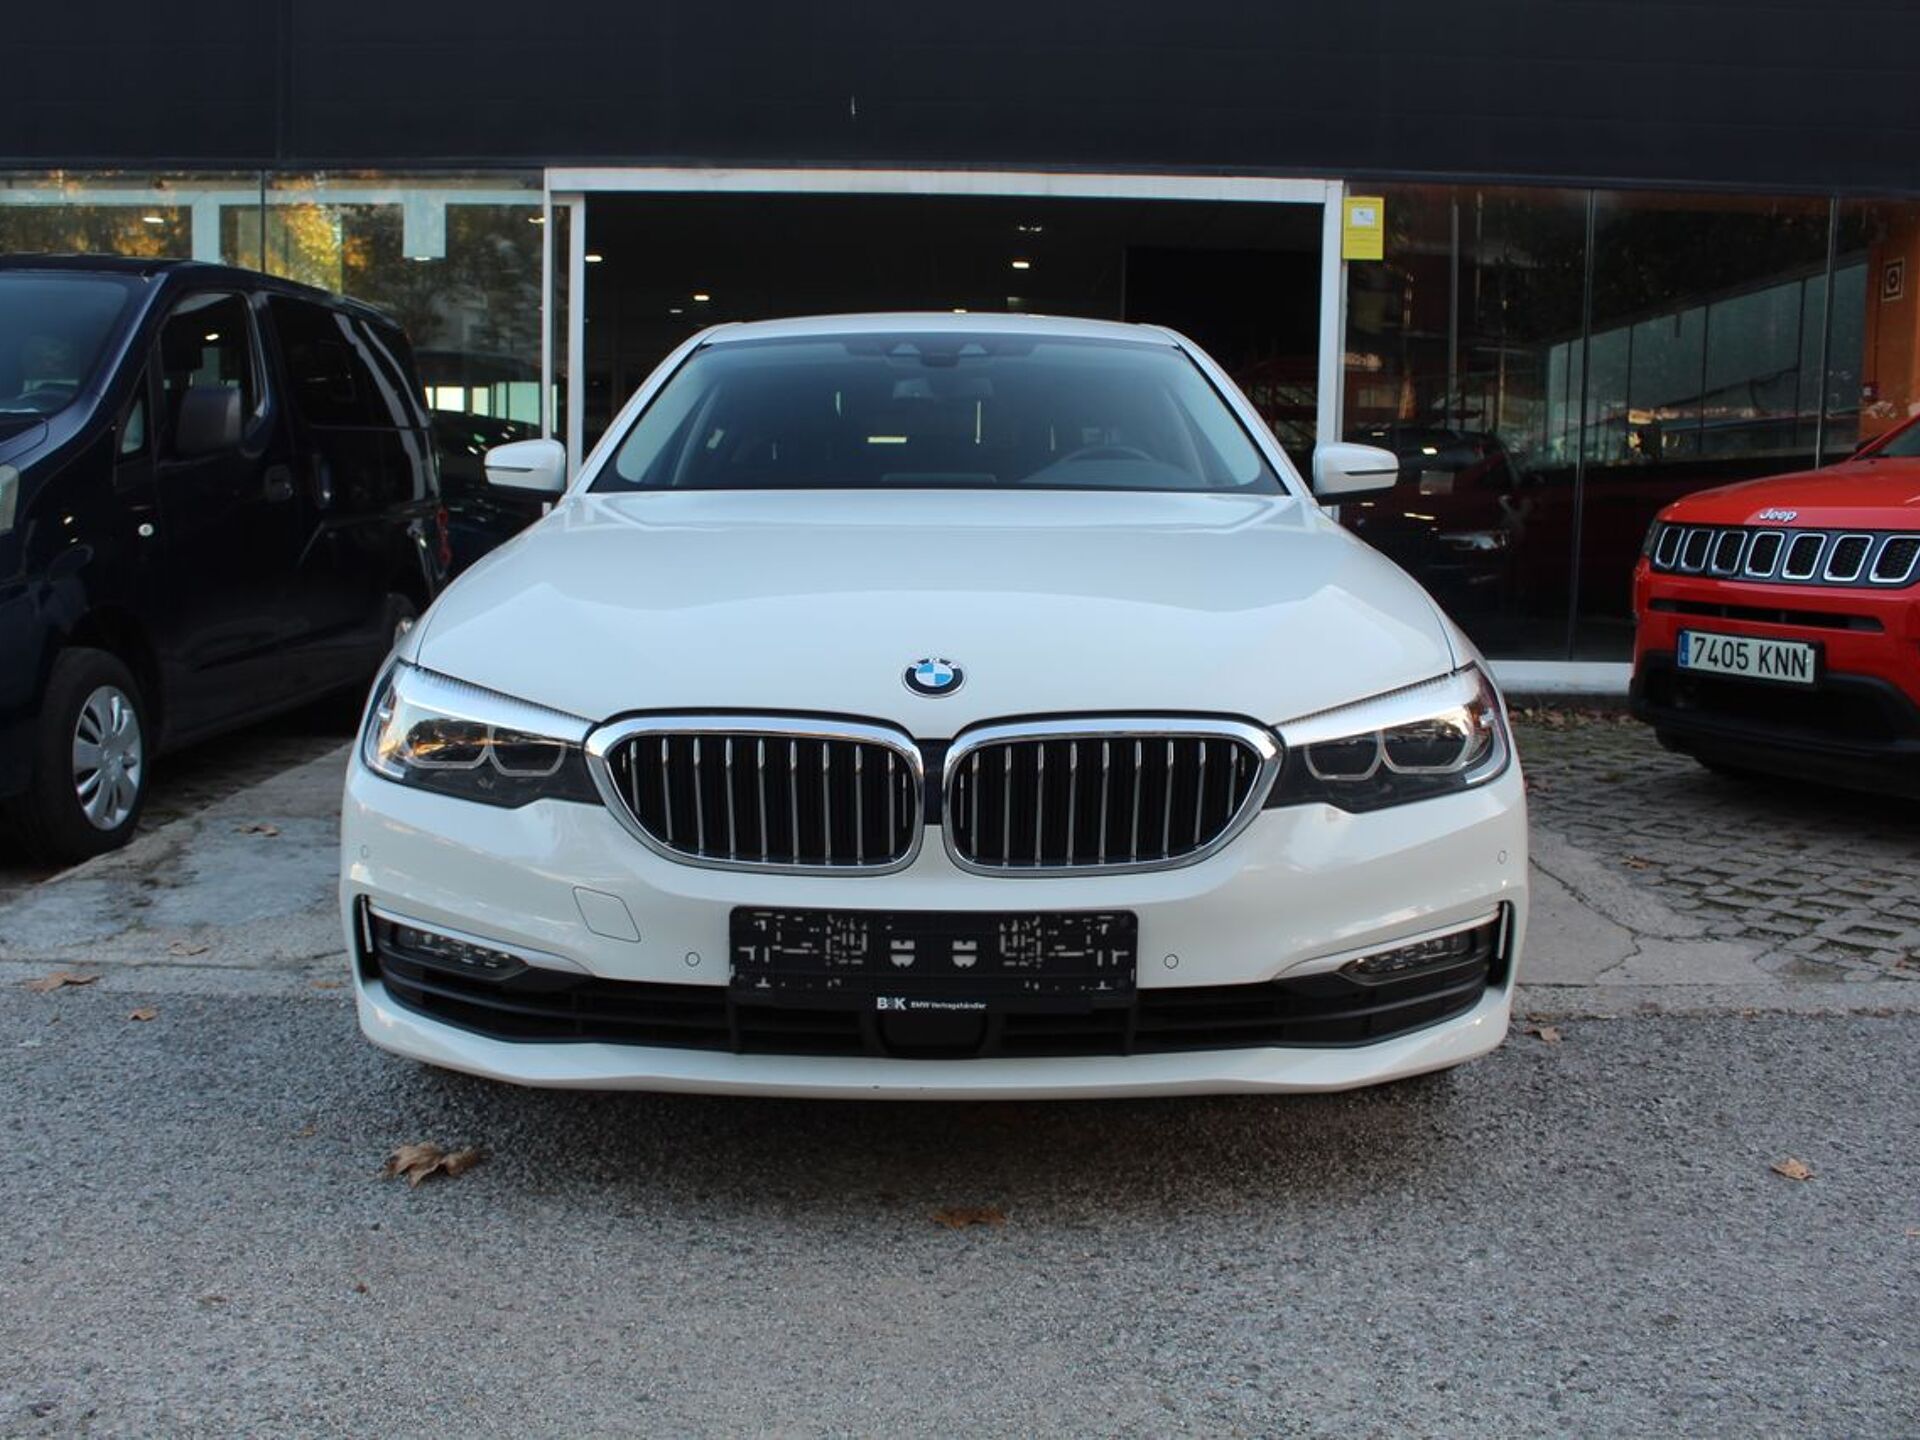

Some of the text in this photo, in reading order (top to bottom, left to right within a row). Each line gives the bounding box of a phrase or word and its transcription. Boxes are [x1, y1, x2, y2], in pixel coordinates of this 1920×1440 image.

[1760, 508, 1797, 522] Jeep
[1694, 637, 1807, 678] 7405 KNN
